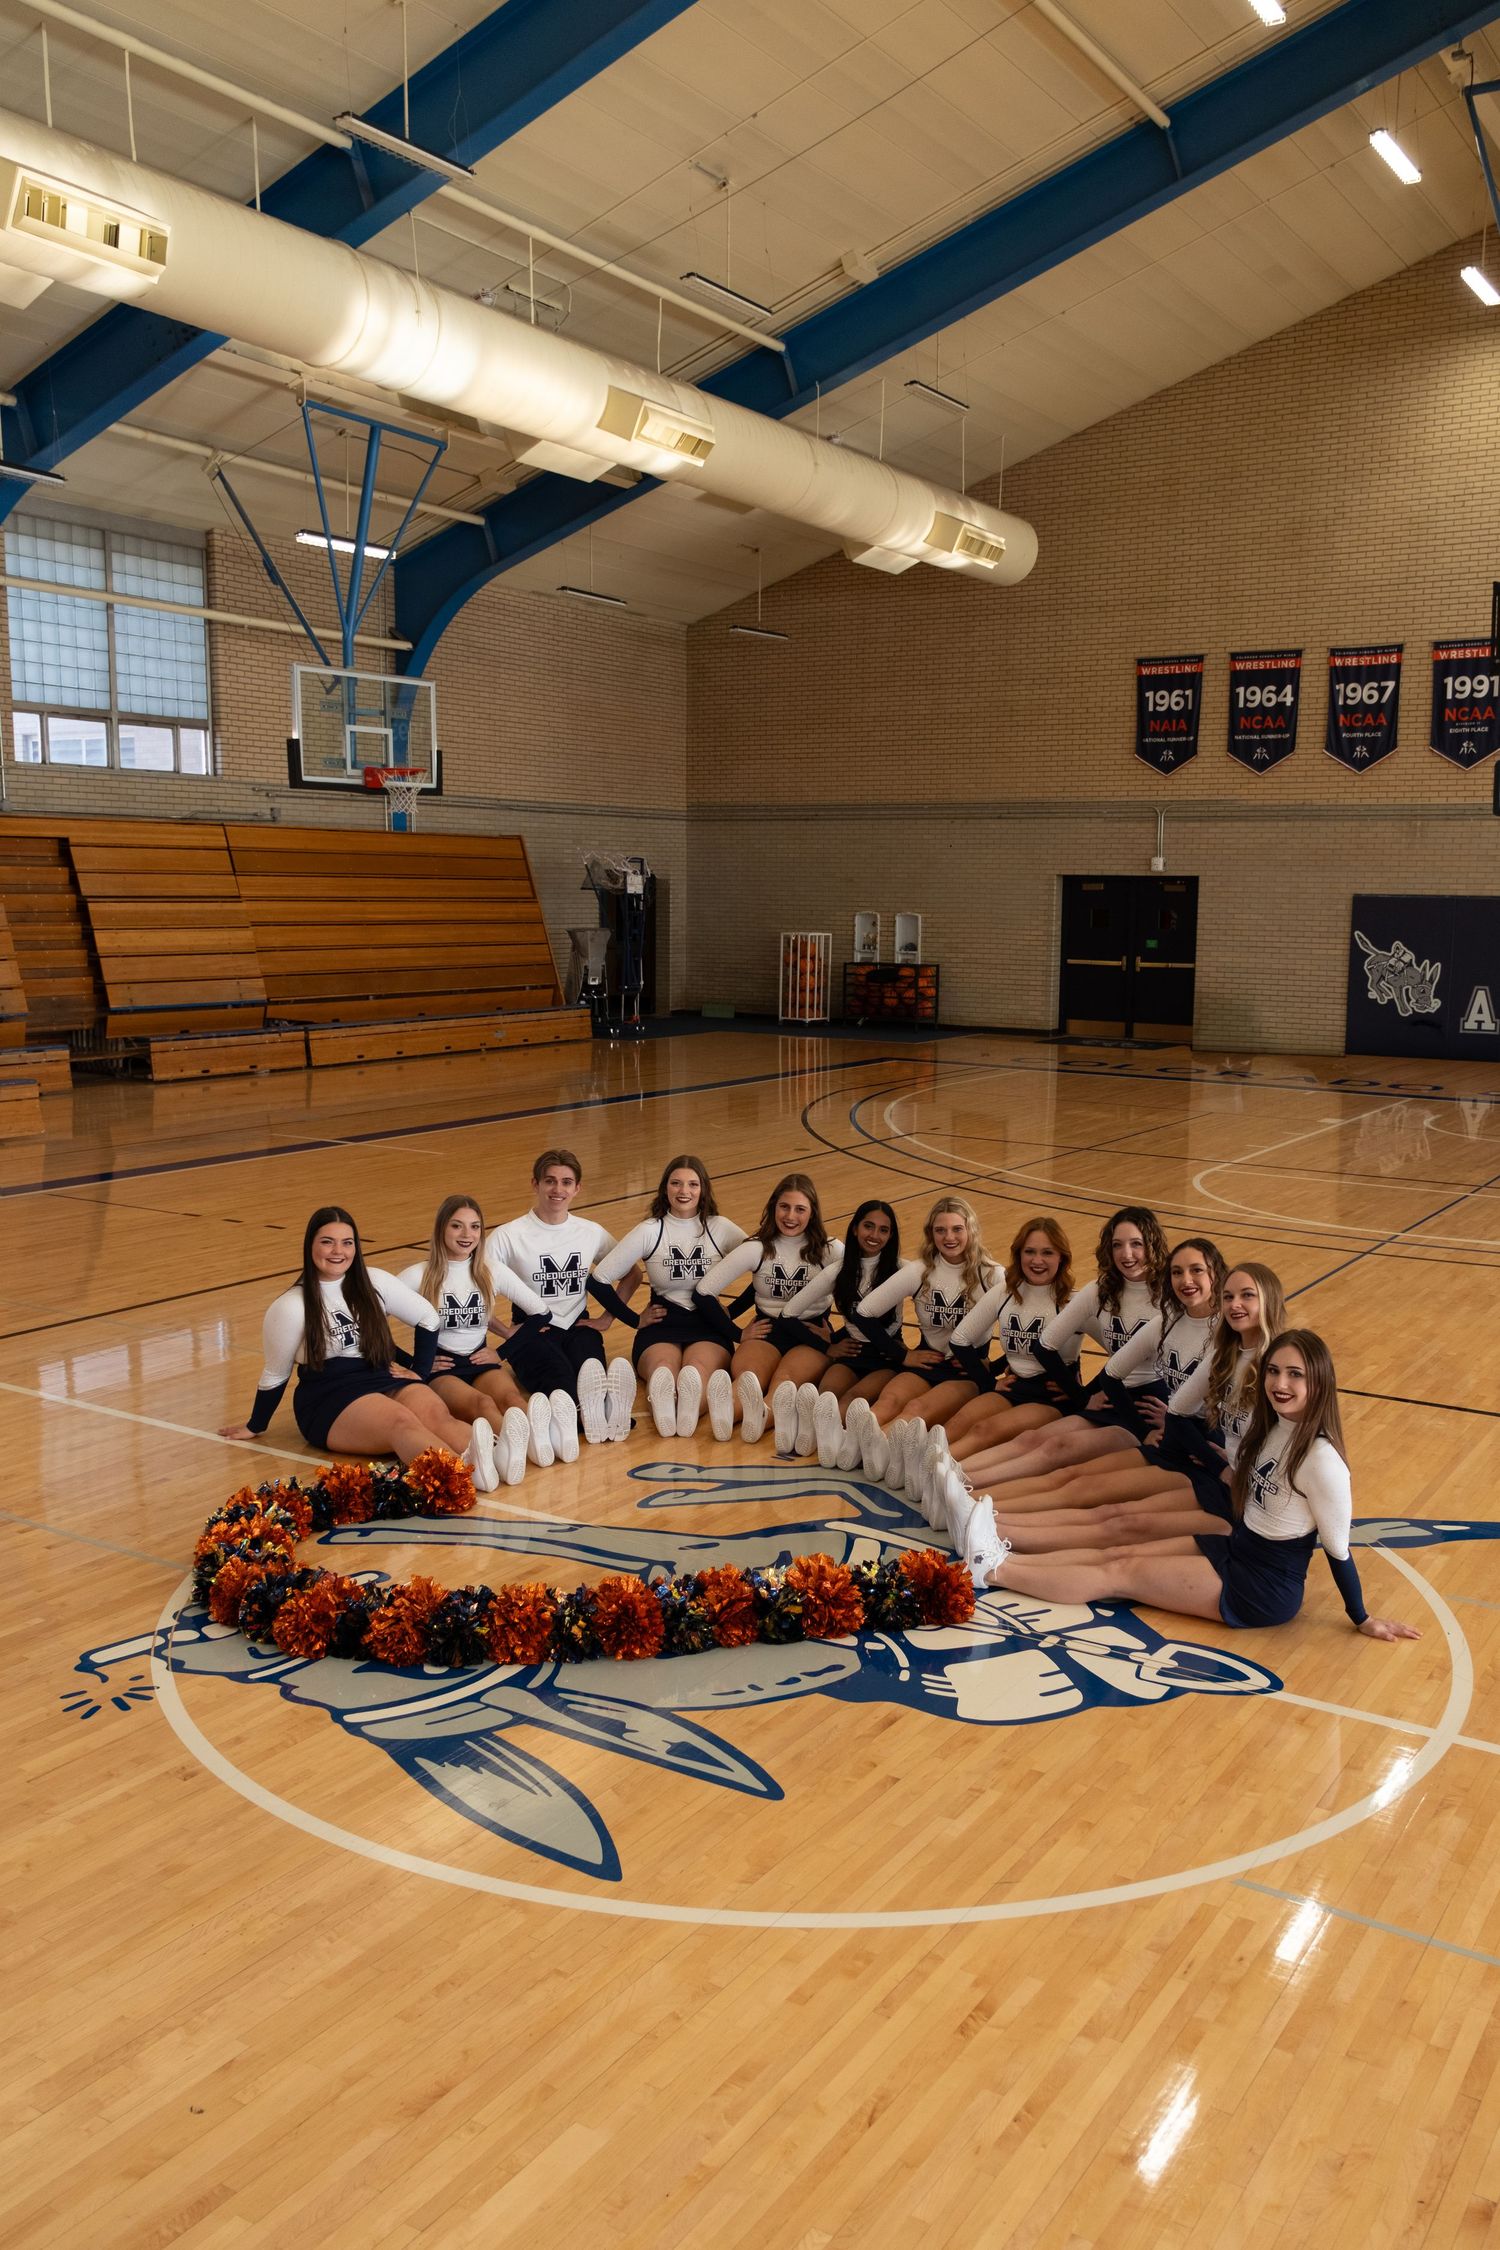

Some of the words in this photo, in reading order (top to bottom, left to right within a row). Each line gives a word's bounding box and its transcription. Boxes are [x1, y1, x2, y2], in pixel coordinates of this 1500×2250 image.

[1335, 654, 1398, 666] WRESTLING
[1439, 649, 1489, 659] WRESTLI
[1142, 665, 1198, 675] WRESTLING
[1235, 660, 1296, 671] WRESTLING
[1335, 681, 1395, 706] 1967
[1443, 674, 1500, 700] 1991
[1145, 689, 1193, 712] 1961
[1235, 684, 1294, 709] 1964
[1338, 712, 1387, 727] NCAA
[1444, 706, 1496, 721] NCAA
[1149, 719, 1188, 732] NAIA
[1239, 715, 1286, 729] NCAA
[663, 1258, 712, 1267] OREDIGGERS
[669, 1245, 707, 1280] M
[532, 1267, 588, 1281] OREDIGGERS
[539, 1252, 583, 1298] M
[765, 1277, 810, 1287] OREDIGGER
[771, 1264, 809, 1300] M
[443, 1291, 482, 1330] M
[931, 1289, 967, 1330] M
[1007, 1314, 1045, 1355] M
